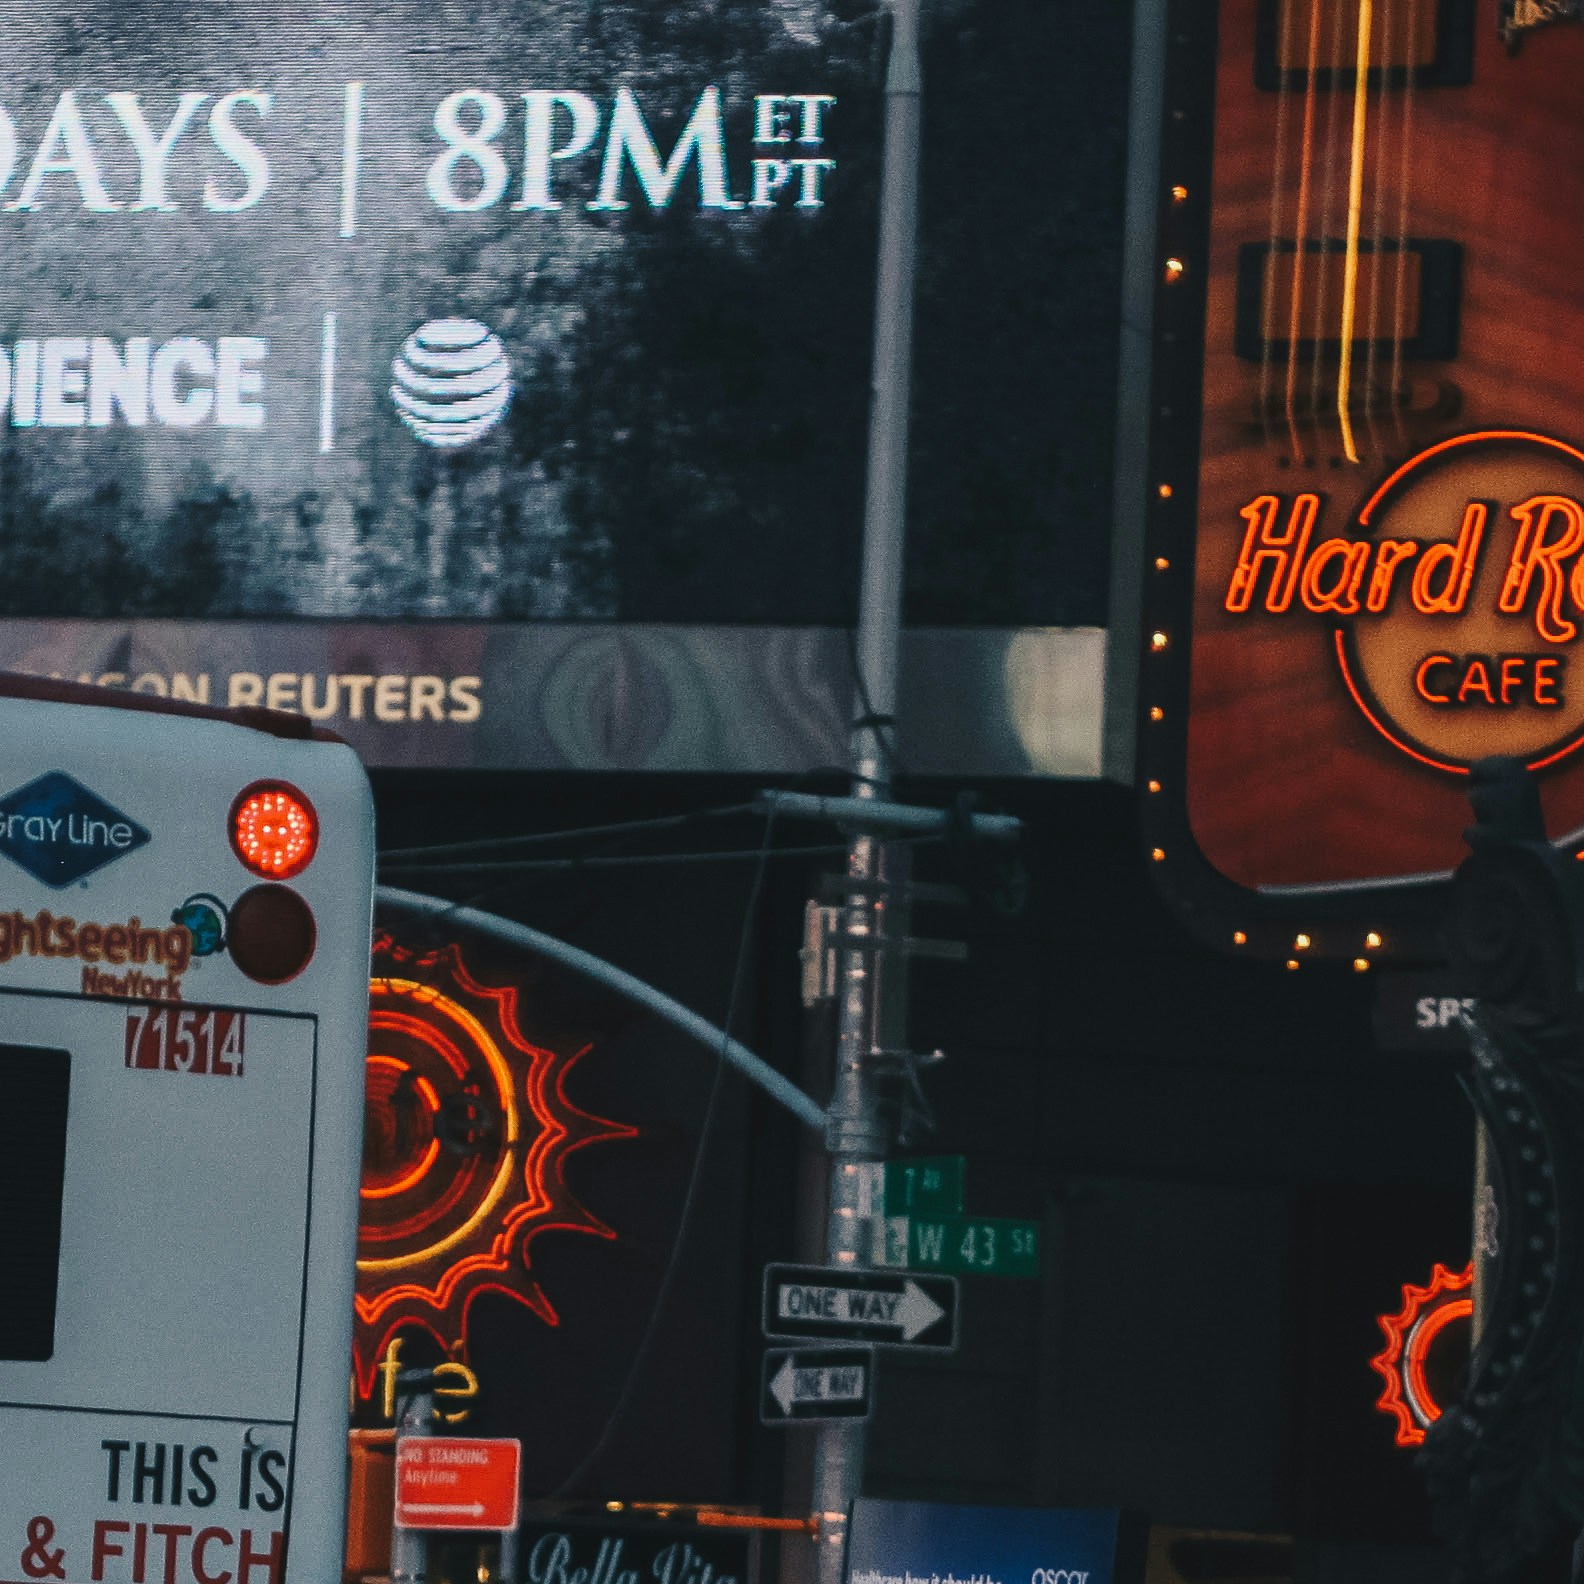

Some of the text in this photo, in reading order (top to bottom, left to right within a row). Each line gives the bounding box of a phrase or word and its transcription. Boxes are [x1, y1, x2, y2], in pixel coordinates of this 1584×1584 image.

[752, 94, 838, 144] ET
[426, 86, 745, 212] 8PM
[750, 158, 838, 208] PT
[1225, 493, 1487, 614] Hard
[228, 671, 482, 722] REUTERS
[1415, 655, 1560, 704] CAFE
[68, 813, 133, 848] Line
[1416, 997, 1475, 1028] SP
[125, 1006, 243, 1076] 71514
[917, 1224, 944, 1261] W
[960, 1226, 994, 1266] 43
[787, 1286, 898, 1321] ONE WAY
[101, 1440, 287, 1513] THIS IS
[20, 1516, 66, 1580] &
